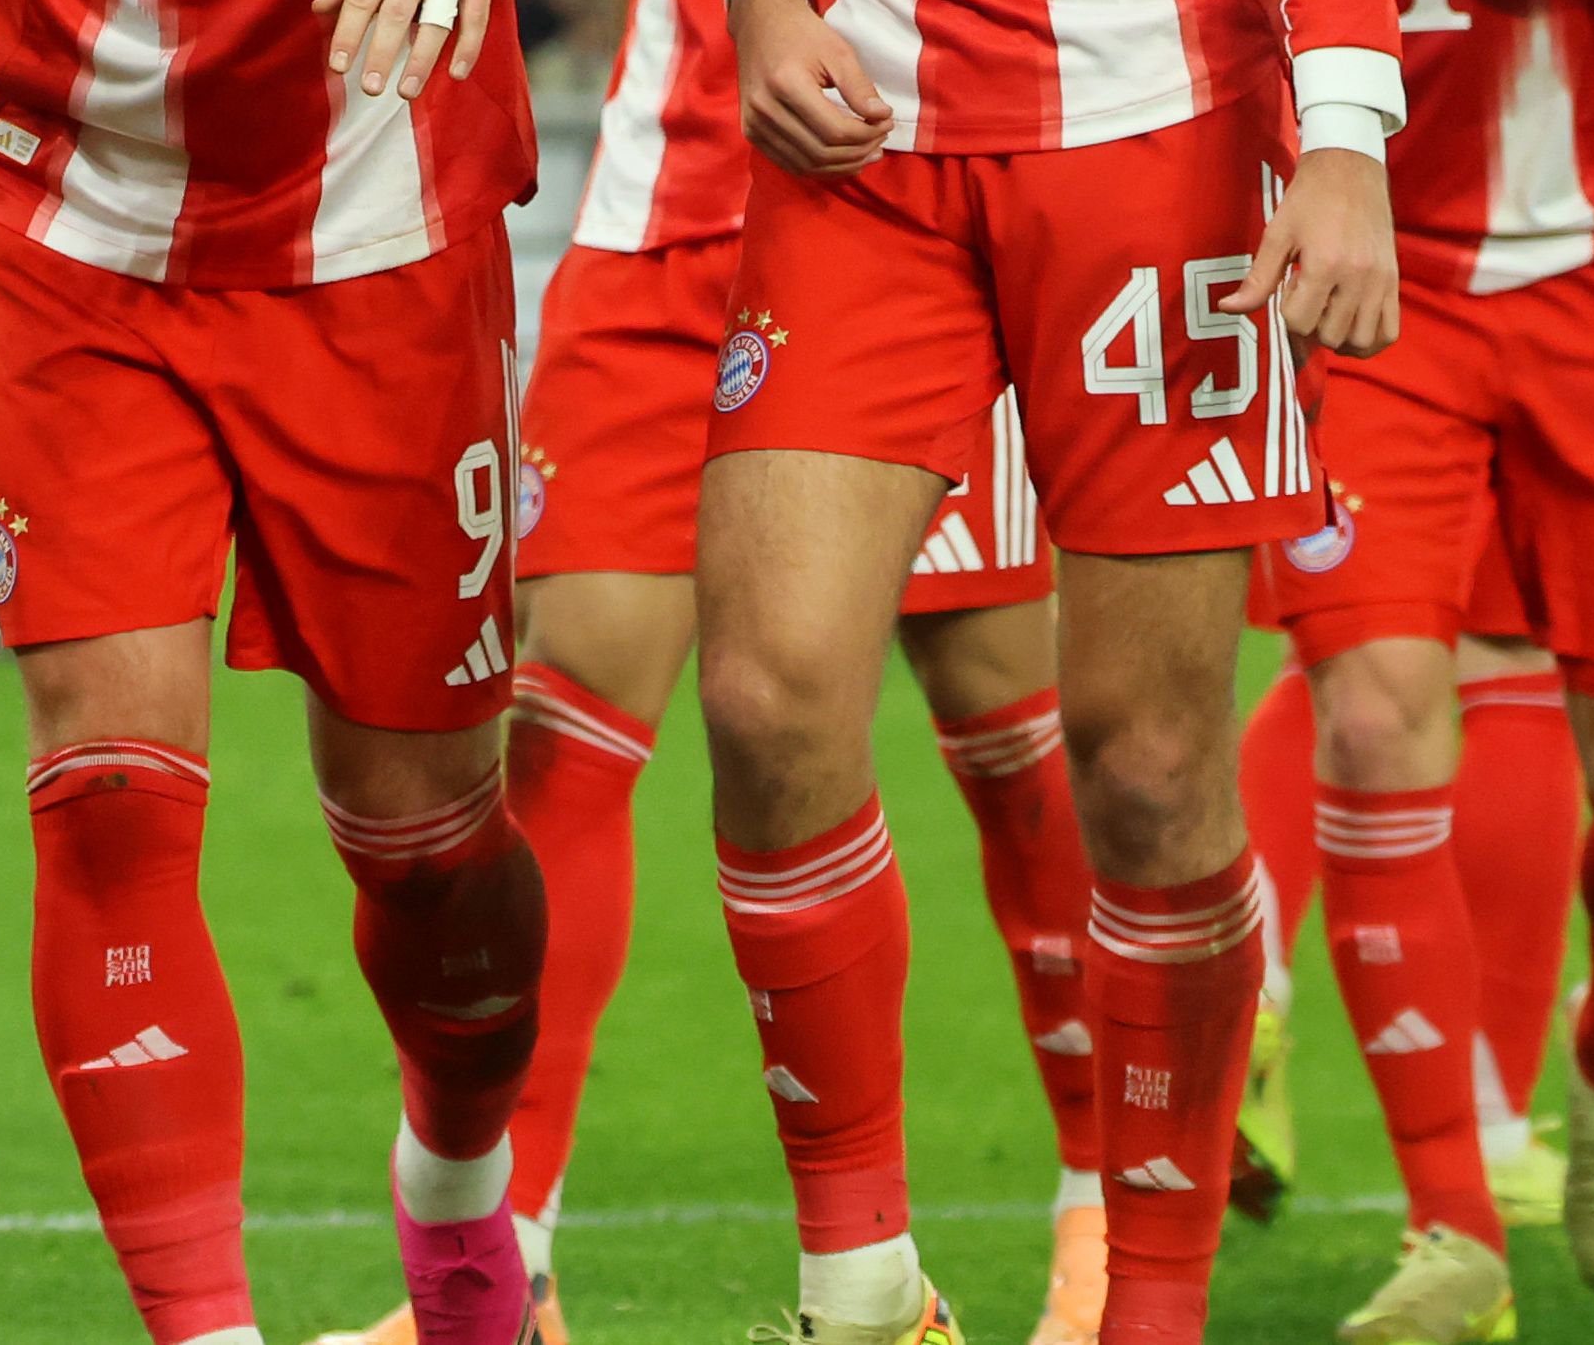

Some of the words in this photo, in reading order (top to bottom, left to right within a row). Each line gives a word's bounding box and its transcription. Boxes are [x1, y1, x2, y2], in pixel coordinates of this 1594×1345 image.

[1081, 254, 1258, 425] 45
[454, 438, 503, 599] 9
[106, 945, 149, 960] MIA
[106, 971, 151, 987] MIA
